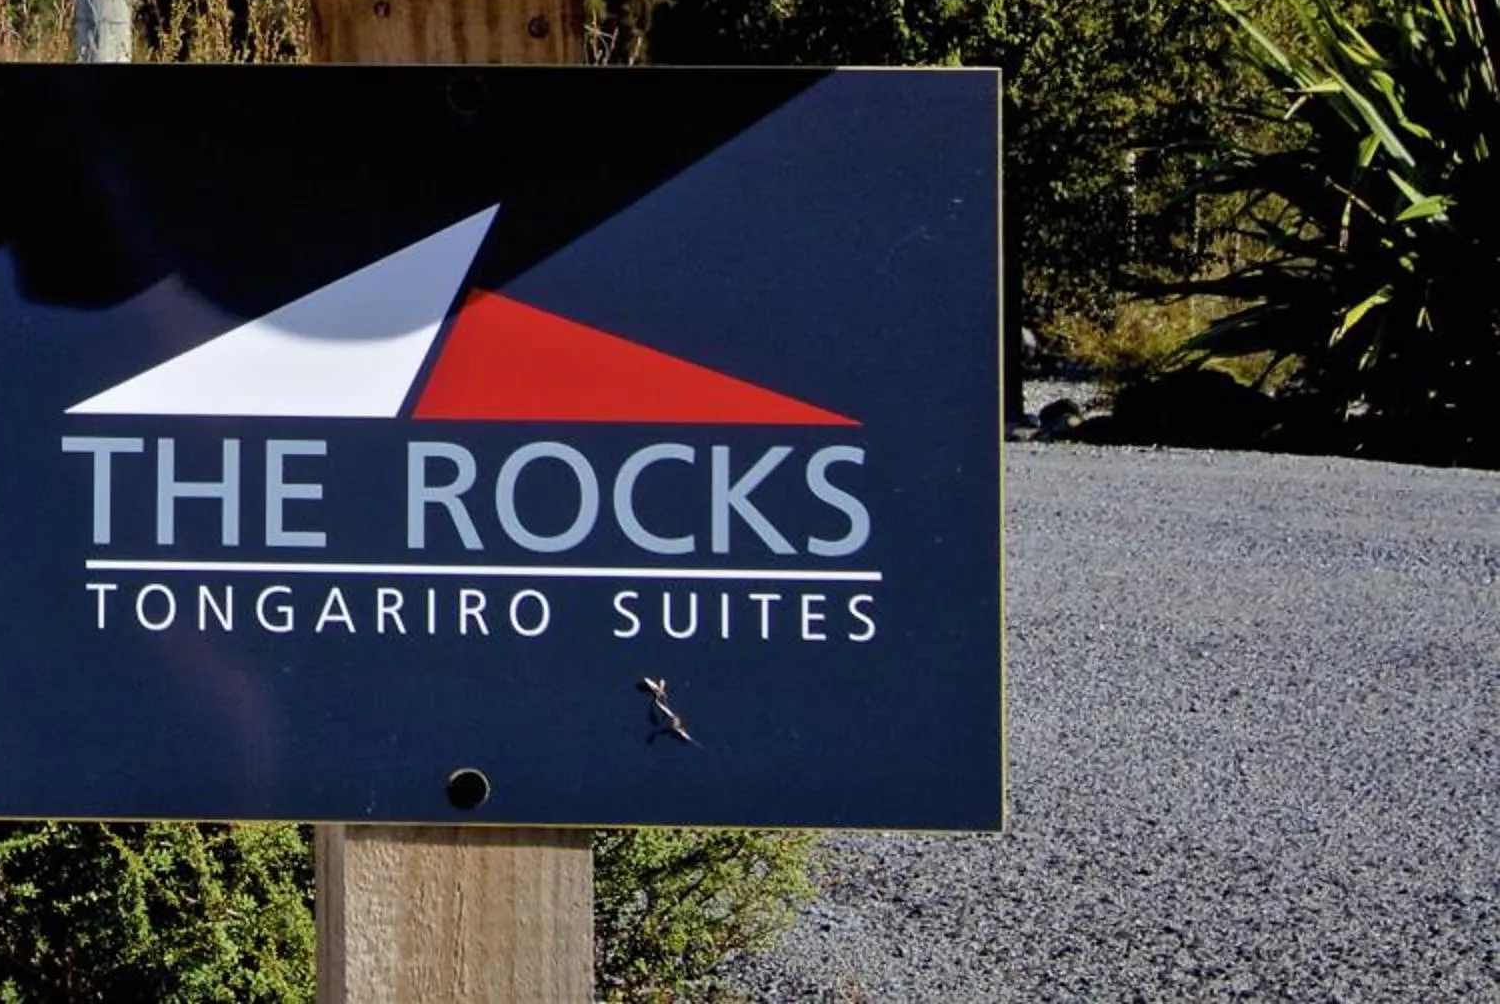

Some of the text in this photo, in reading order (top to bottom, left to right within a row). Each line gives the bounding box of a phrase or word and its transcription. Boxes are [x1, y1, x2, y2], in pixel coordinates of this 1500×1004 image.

[61, 436, 872, 557] THE ROCKS
[85, 583, 877, 643] TONGARIRO SUITES
